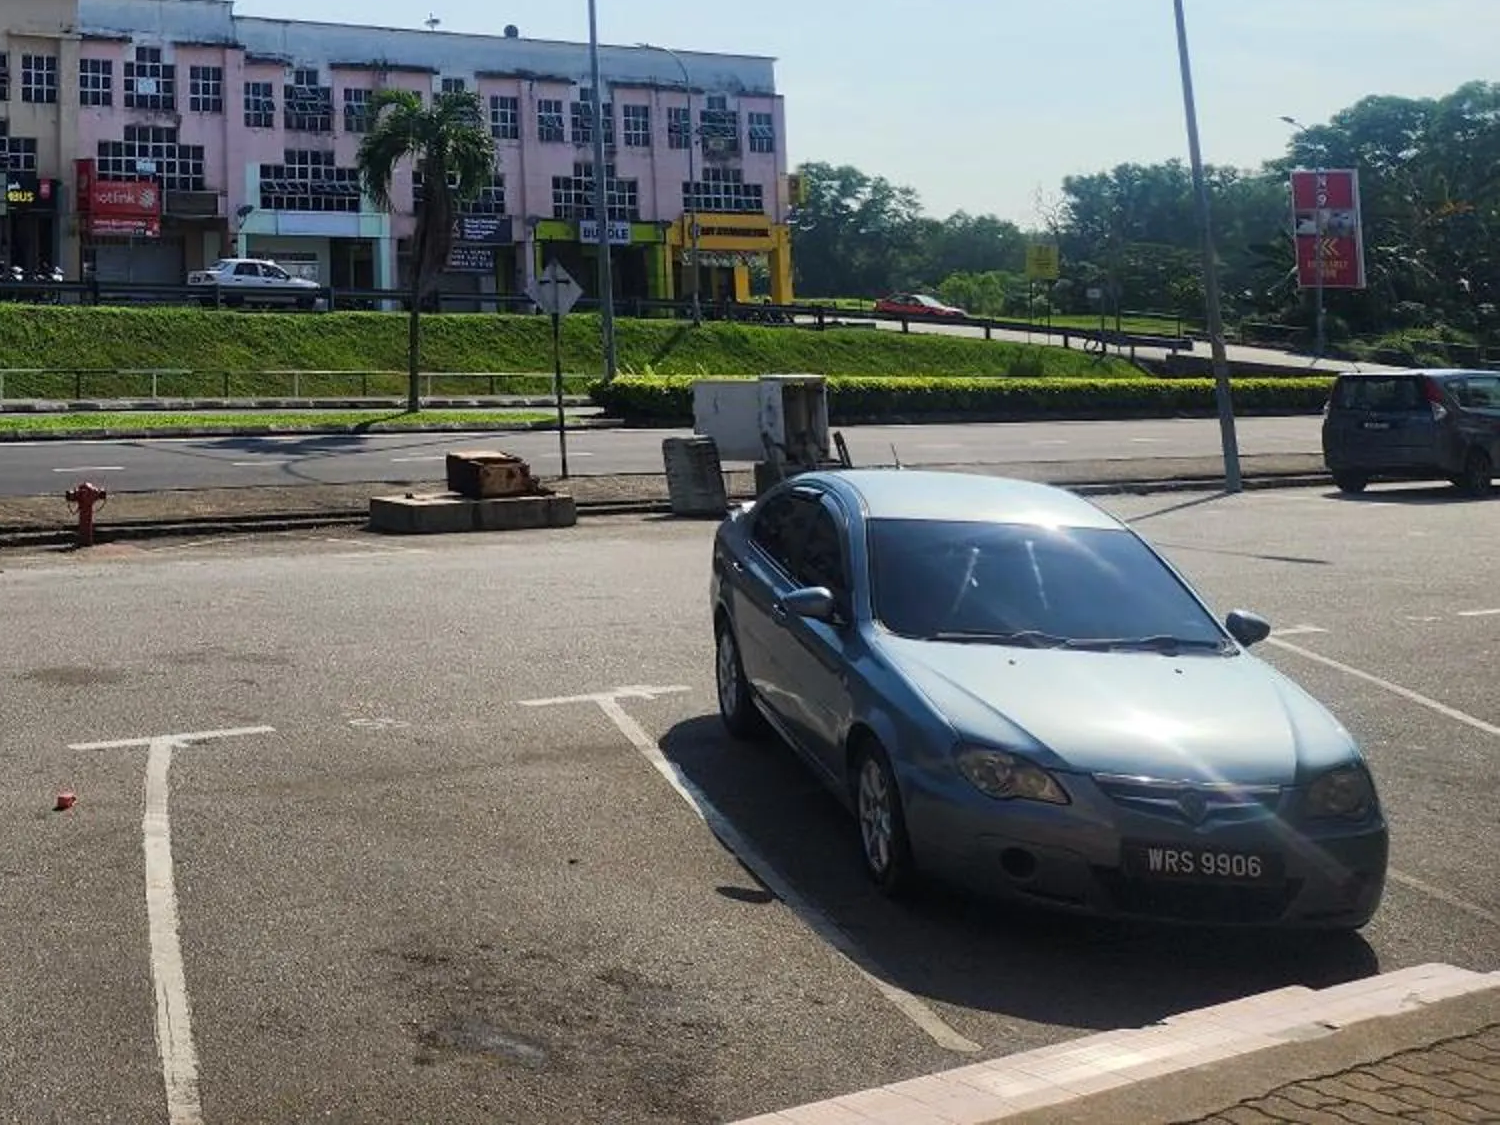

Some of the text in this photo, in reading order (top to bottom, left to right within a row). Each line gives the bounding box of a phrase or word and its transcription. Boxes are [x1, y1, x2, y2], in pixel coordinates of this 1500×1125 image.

[96, 190, 136, 204] otlink
[583, 226, 629, 240] BUDLE
[1148, 848, 1262, 877] WRS 9906
